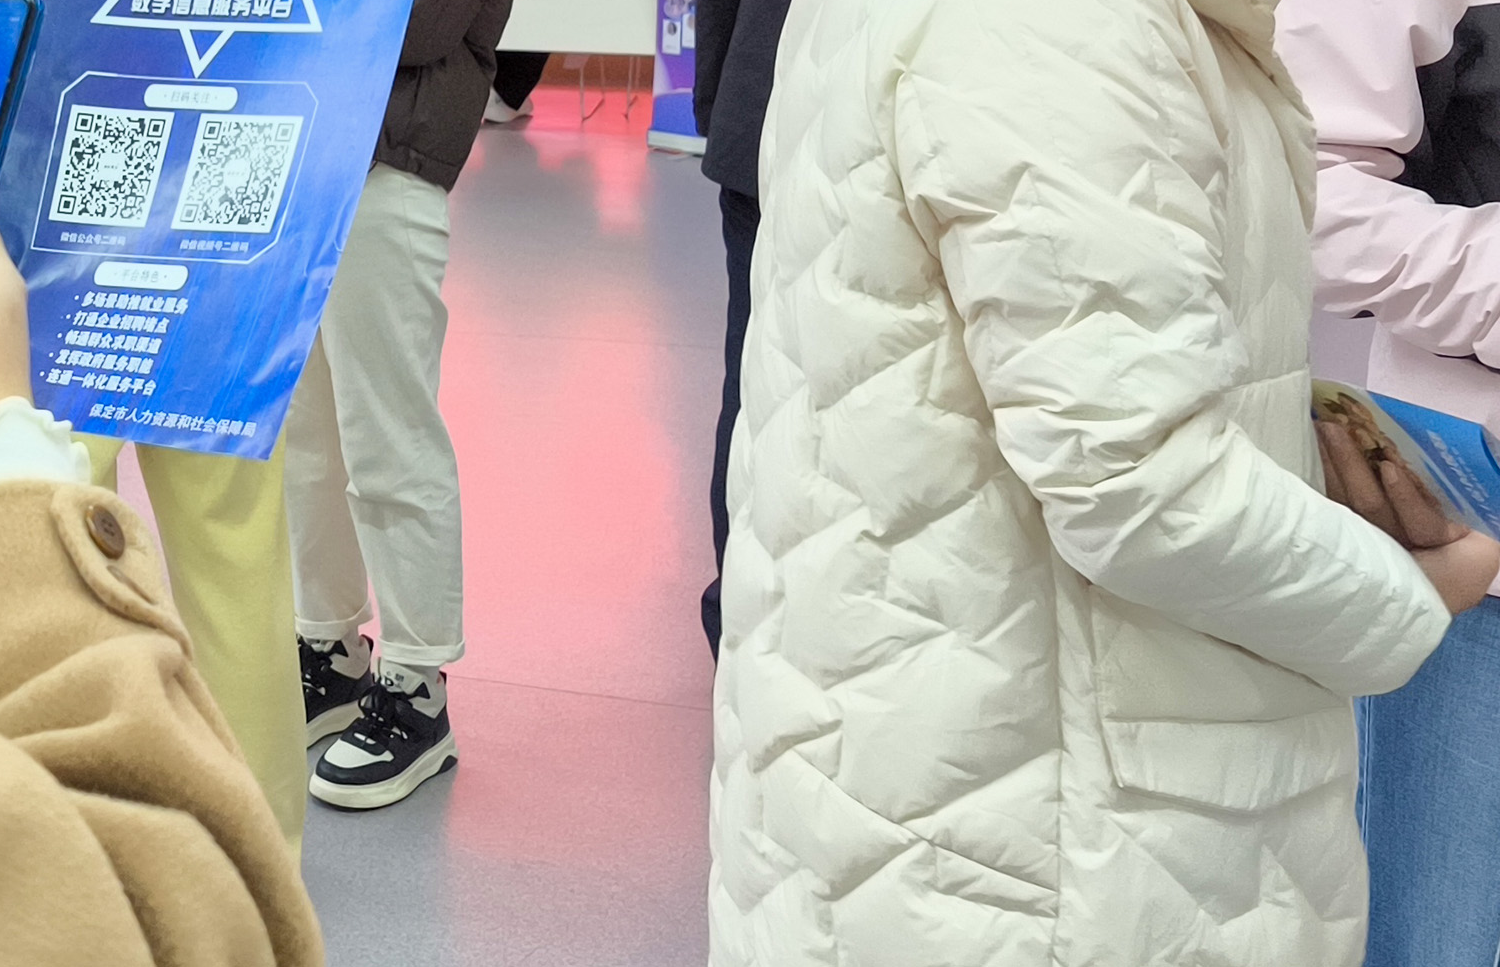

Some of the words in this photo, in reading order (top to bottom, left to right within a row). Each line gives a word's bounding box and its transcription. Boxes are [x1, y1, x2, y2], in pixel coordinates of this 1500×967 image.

[89, 403, 258, 438] 保定市人力资源和社会保障局
